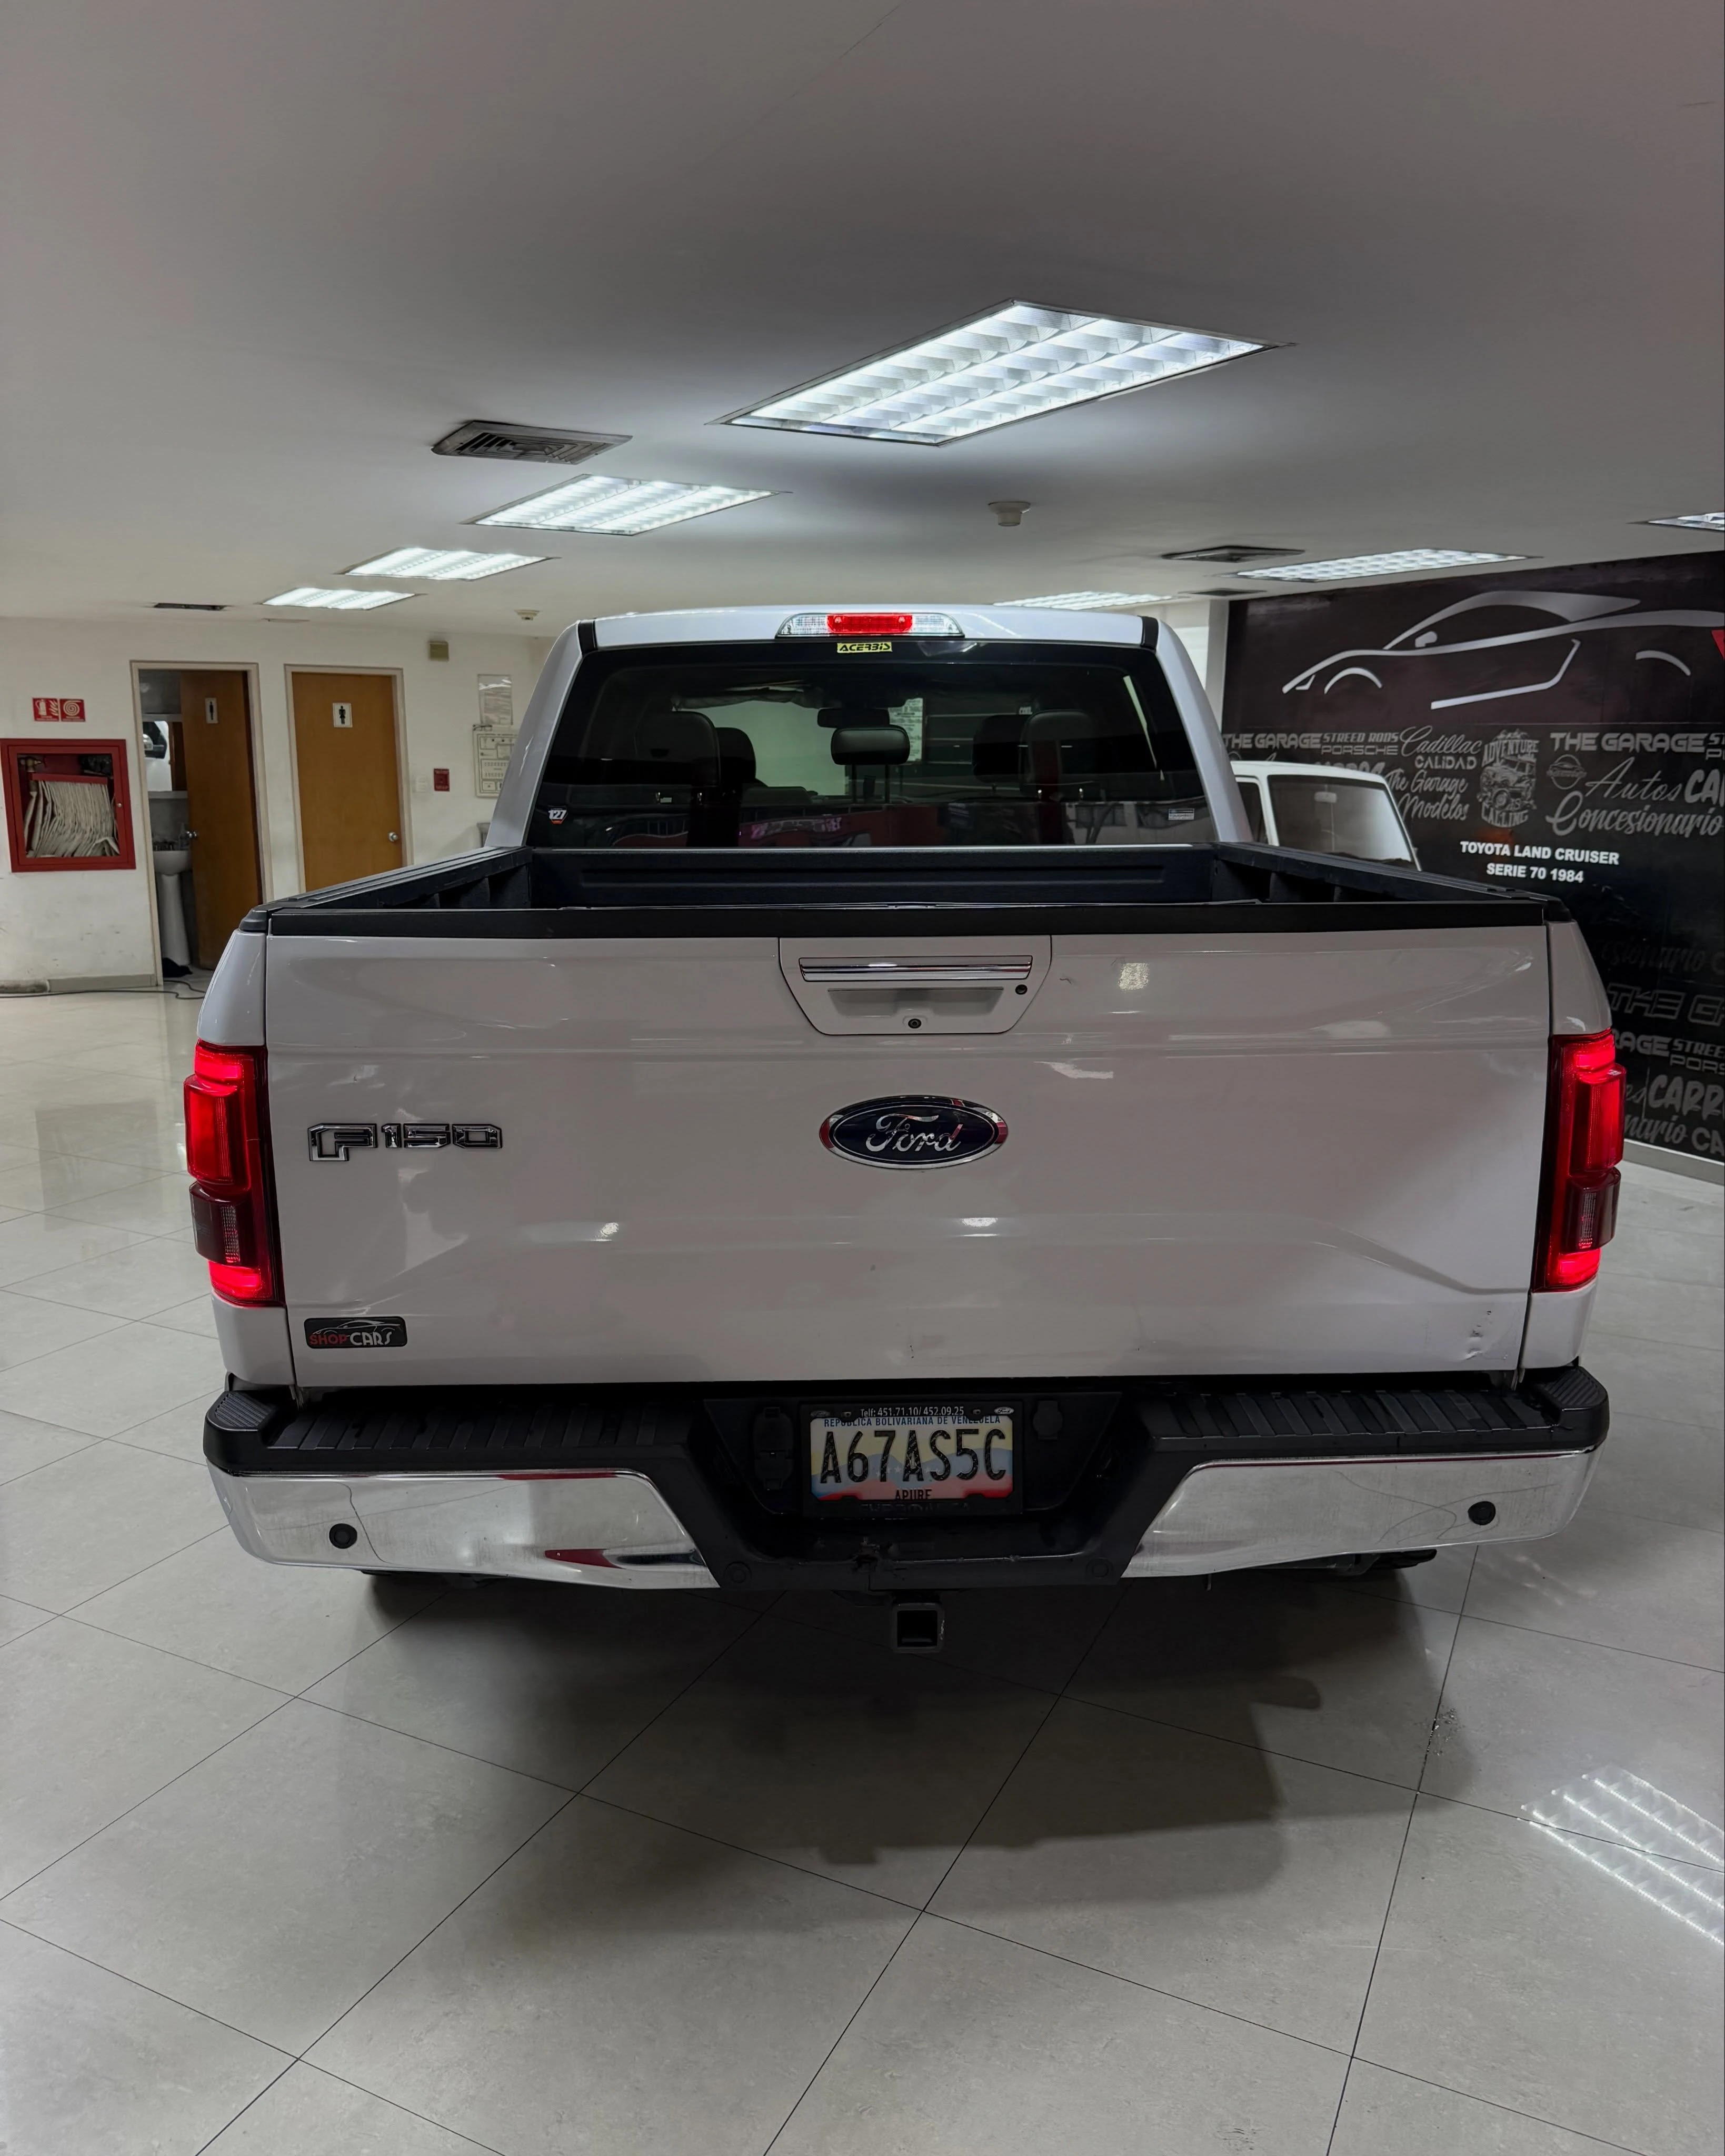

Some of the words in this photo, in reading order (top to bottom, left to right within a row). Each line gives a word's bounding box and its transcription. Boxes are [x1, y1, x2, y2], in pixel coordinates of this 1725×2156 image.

[1255, 733, 1322, 748] GARAGE
[1321, 745, 1398, 755] PORSCHE
[1400, 725, 1482, 757] Cadillac
[1550, 732, 1600, 752] THE
[1601, 733, 1708, 753] GARAGE
[1481, 740, 1540, 767] ADVENTURE
[1411, 769, 1469, 799] Garage
[1585, 756, 1682, 801] Autos
[548, 809, 566, 820] 127
[1397, 793, 1470, 821] Modelos
[1460, 841, 1511, 856] TOYOTA
[1513, 845, 1551, 859] LAND
[1554, 848, 1619, 865] CRUISER
[1486, 863, 1527, 879] SERIE
[1530, 866, 1547, 880] 70
[1550, 869, 1584, 883] 1984
[865, 1113, 963, 1152] Ford
[310, 1334, 347, 1345] SHOP
[350, 1331, 392, 1346] CARS
[860, 1409, 875, 1417] Telf:
[876, 1416, 933, 1426] BOLIVARIANA
[820, 1428, 1006, 1484] A67AS5C
[895, 1489, 932, 1500] APURE
